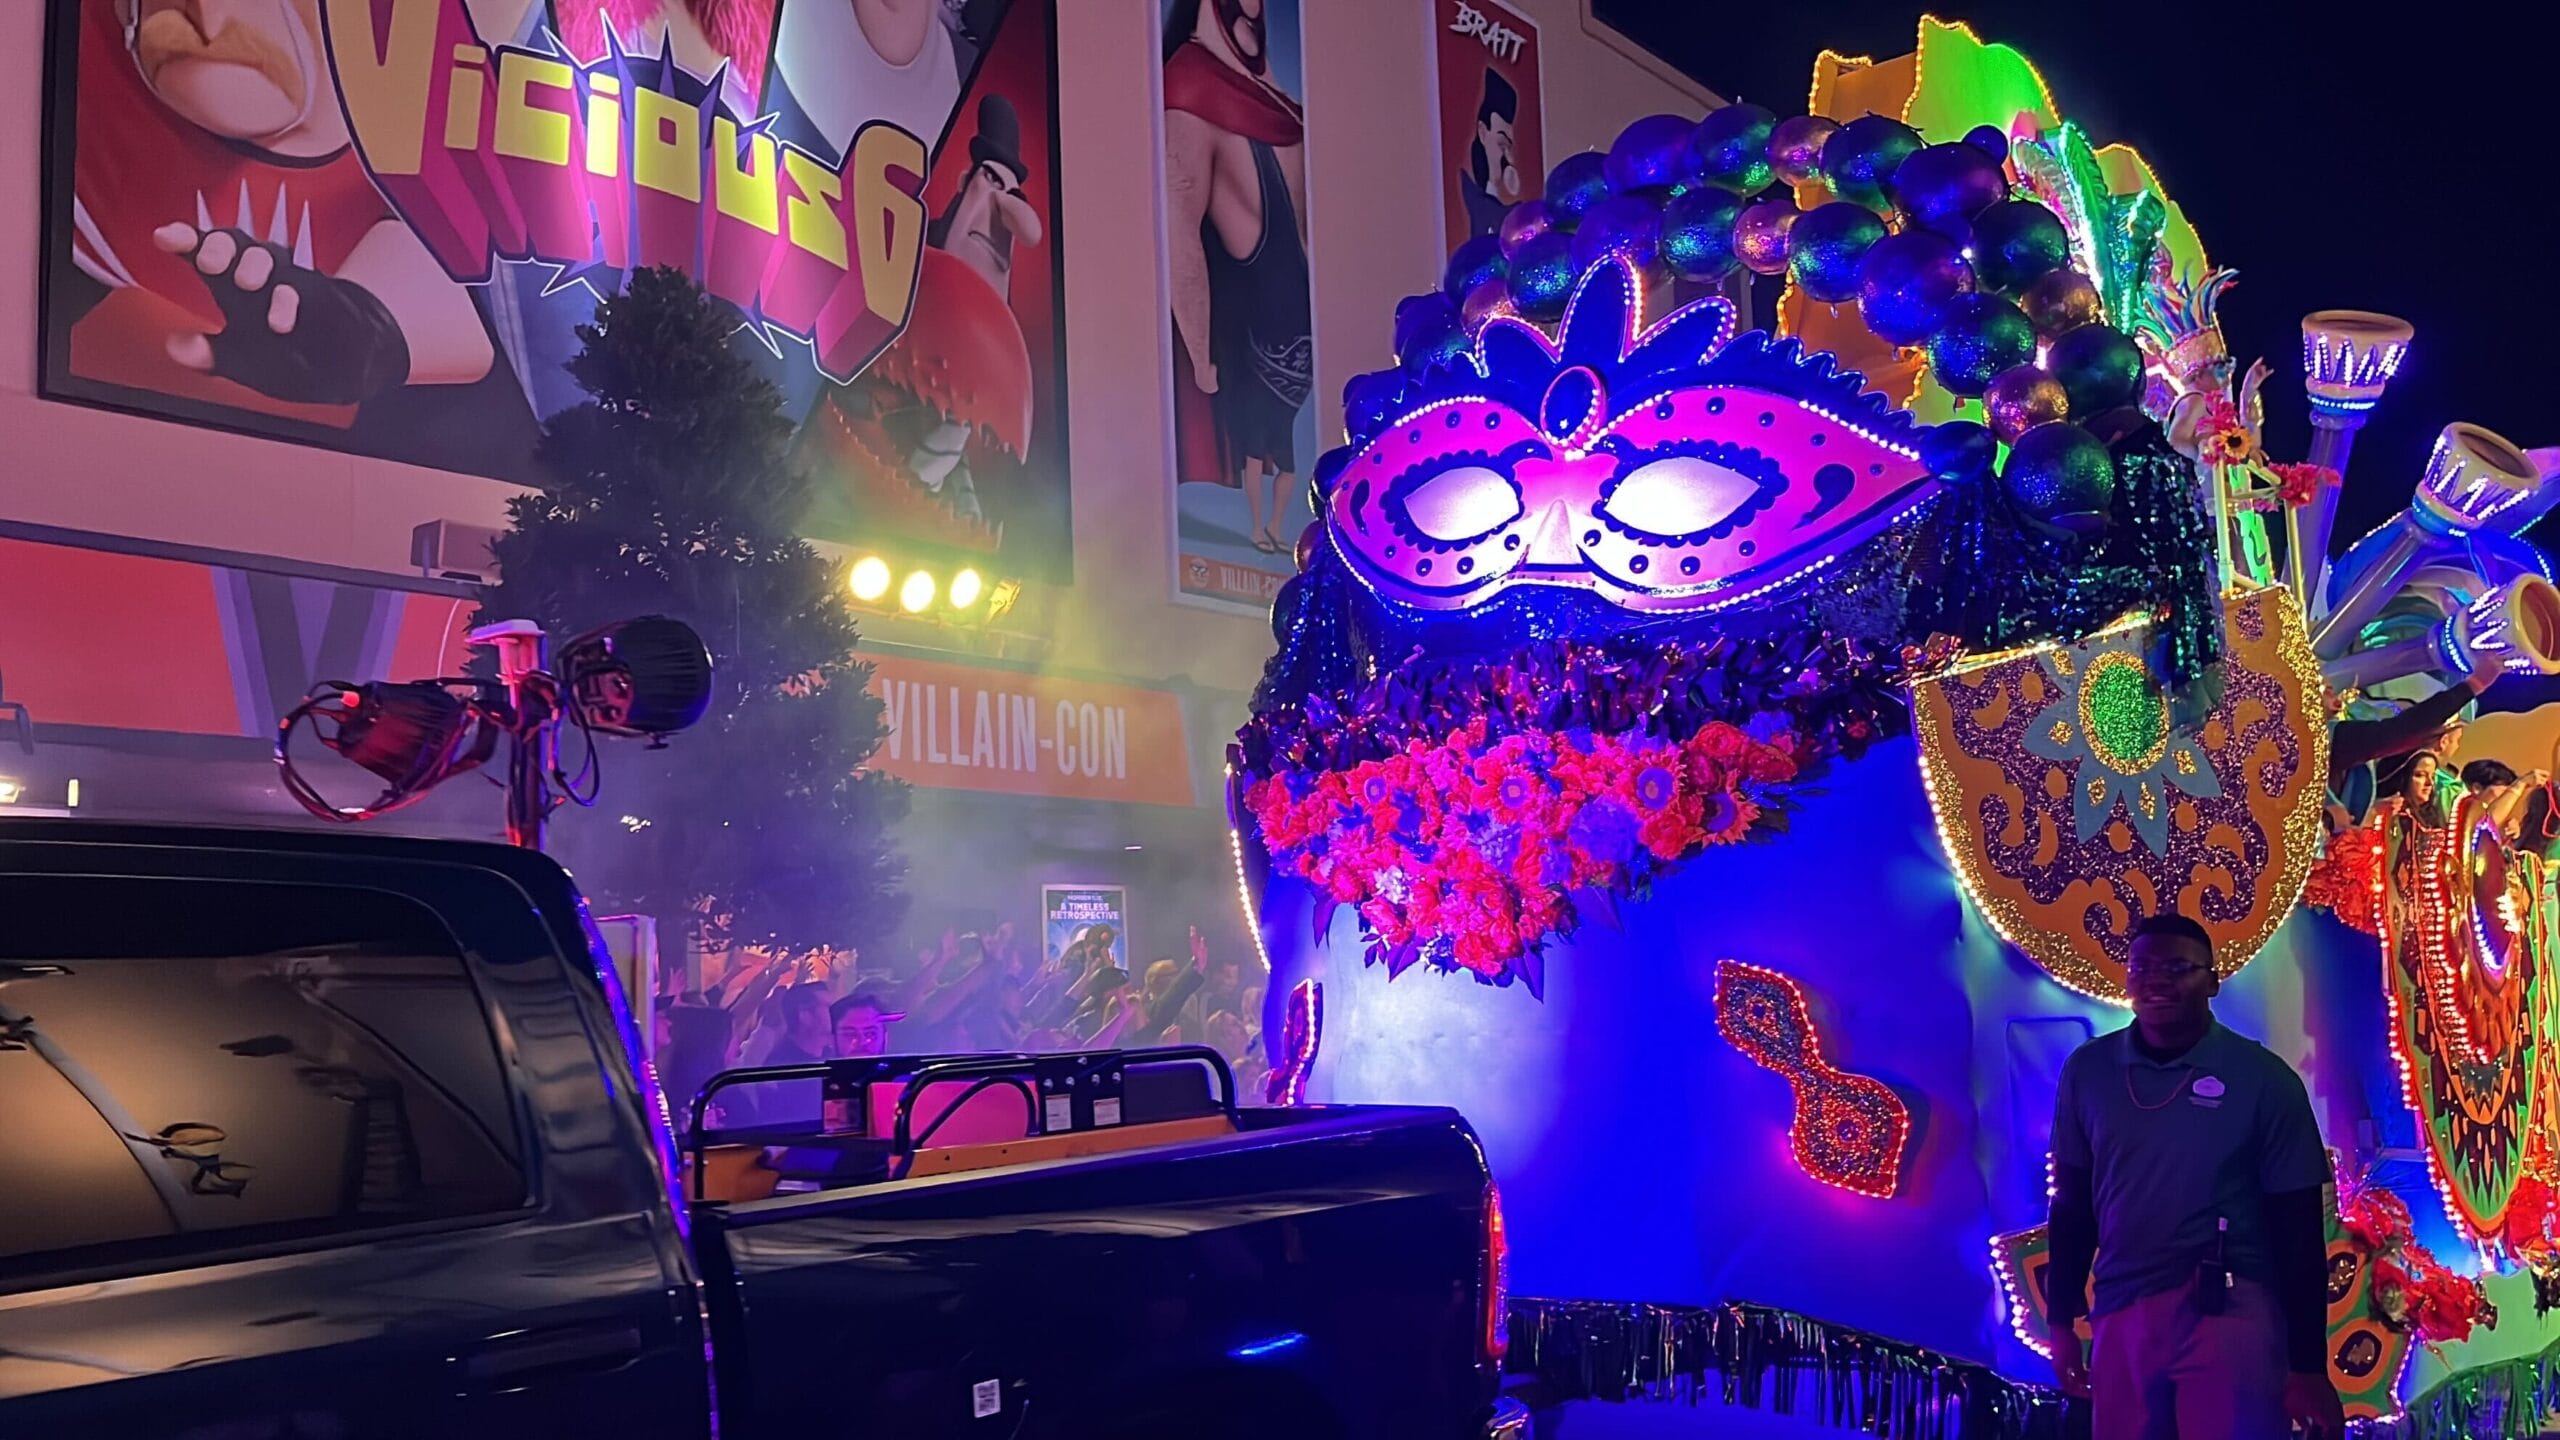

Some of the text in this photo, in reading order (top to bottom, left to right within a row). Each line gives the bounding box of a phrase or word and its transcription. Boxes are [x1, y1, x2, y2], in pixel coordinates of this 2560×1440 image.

[1448, 0, 1528, 64] BRATT
[882, 678, 1126, 780] VILLAIN-CON
[1050, 910, 1119, 920] RETROSPECTIVE
[1060, 902, 1110, 911] A TIMELESS
